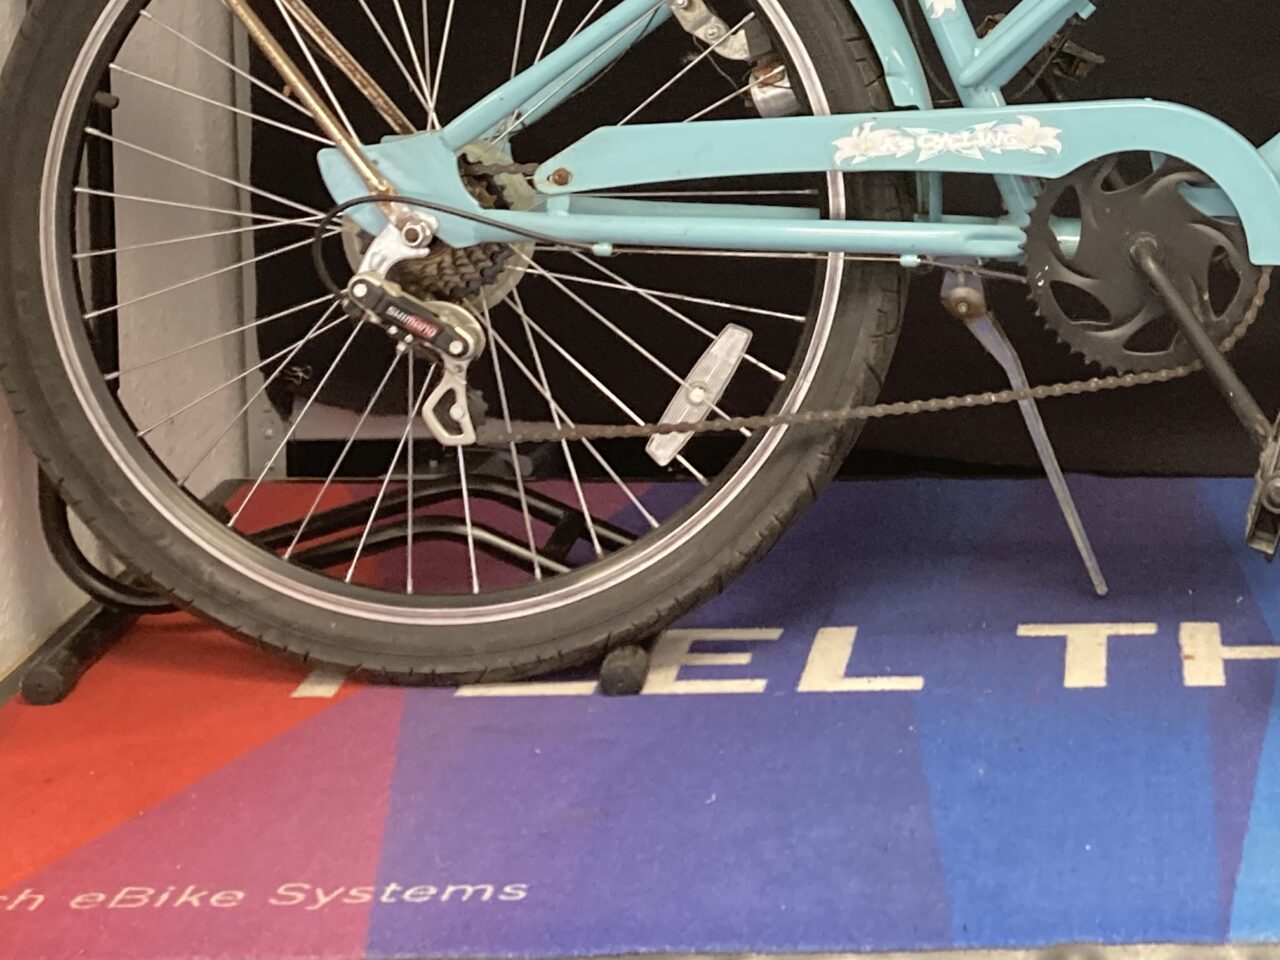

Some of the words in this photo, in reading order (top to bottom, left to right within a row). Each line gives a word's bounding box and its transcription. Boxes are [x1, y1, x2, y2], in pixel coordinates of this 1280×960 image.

[916, 127, 1018, 150] CYCLING
[70, 884, 245, 909] eBike
[268, 881, 529, 912] Systems
